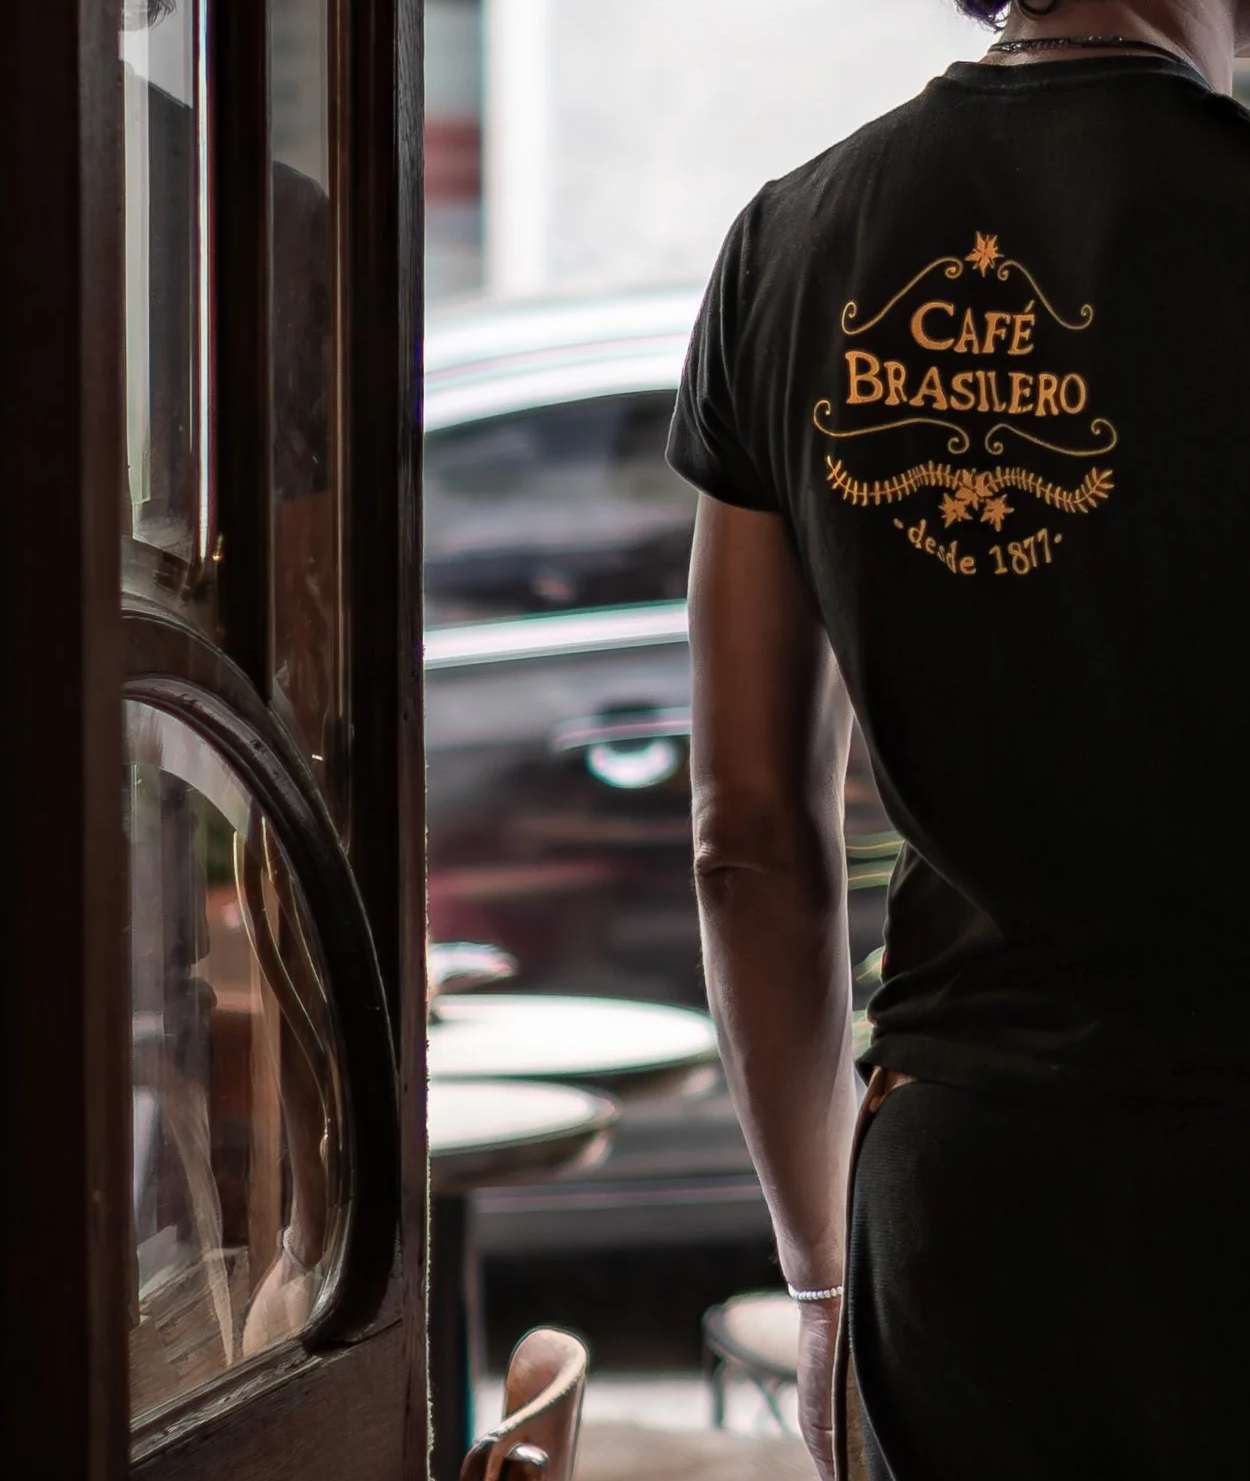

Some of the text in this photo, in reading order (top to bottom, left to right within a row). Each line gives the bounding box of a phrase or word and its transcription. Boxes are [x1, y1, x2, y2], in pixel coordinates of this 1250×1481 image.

[911, 300, 1036, 354] CAFÉ
[845, 351, 1087, 416] BRASILERO
[908, 520, 1051, 574] desde 1877
